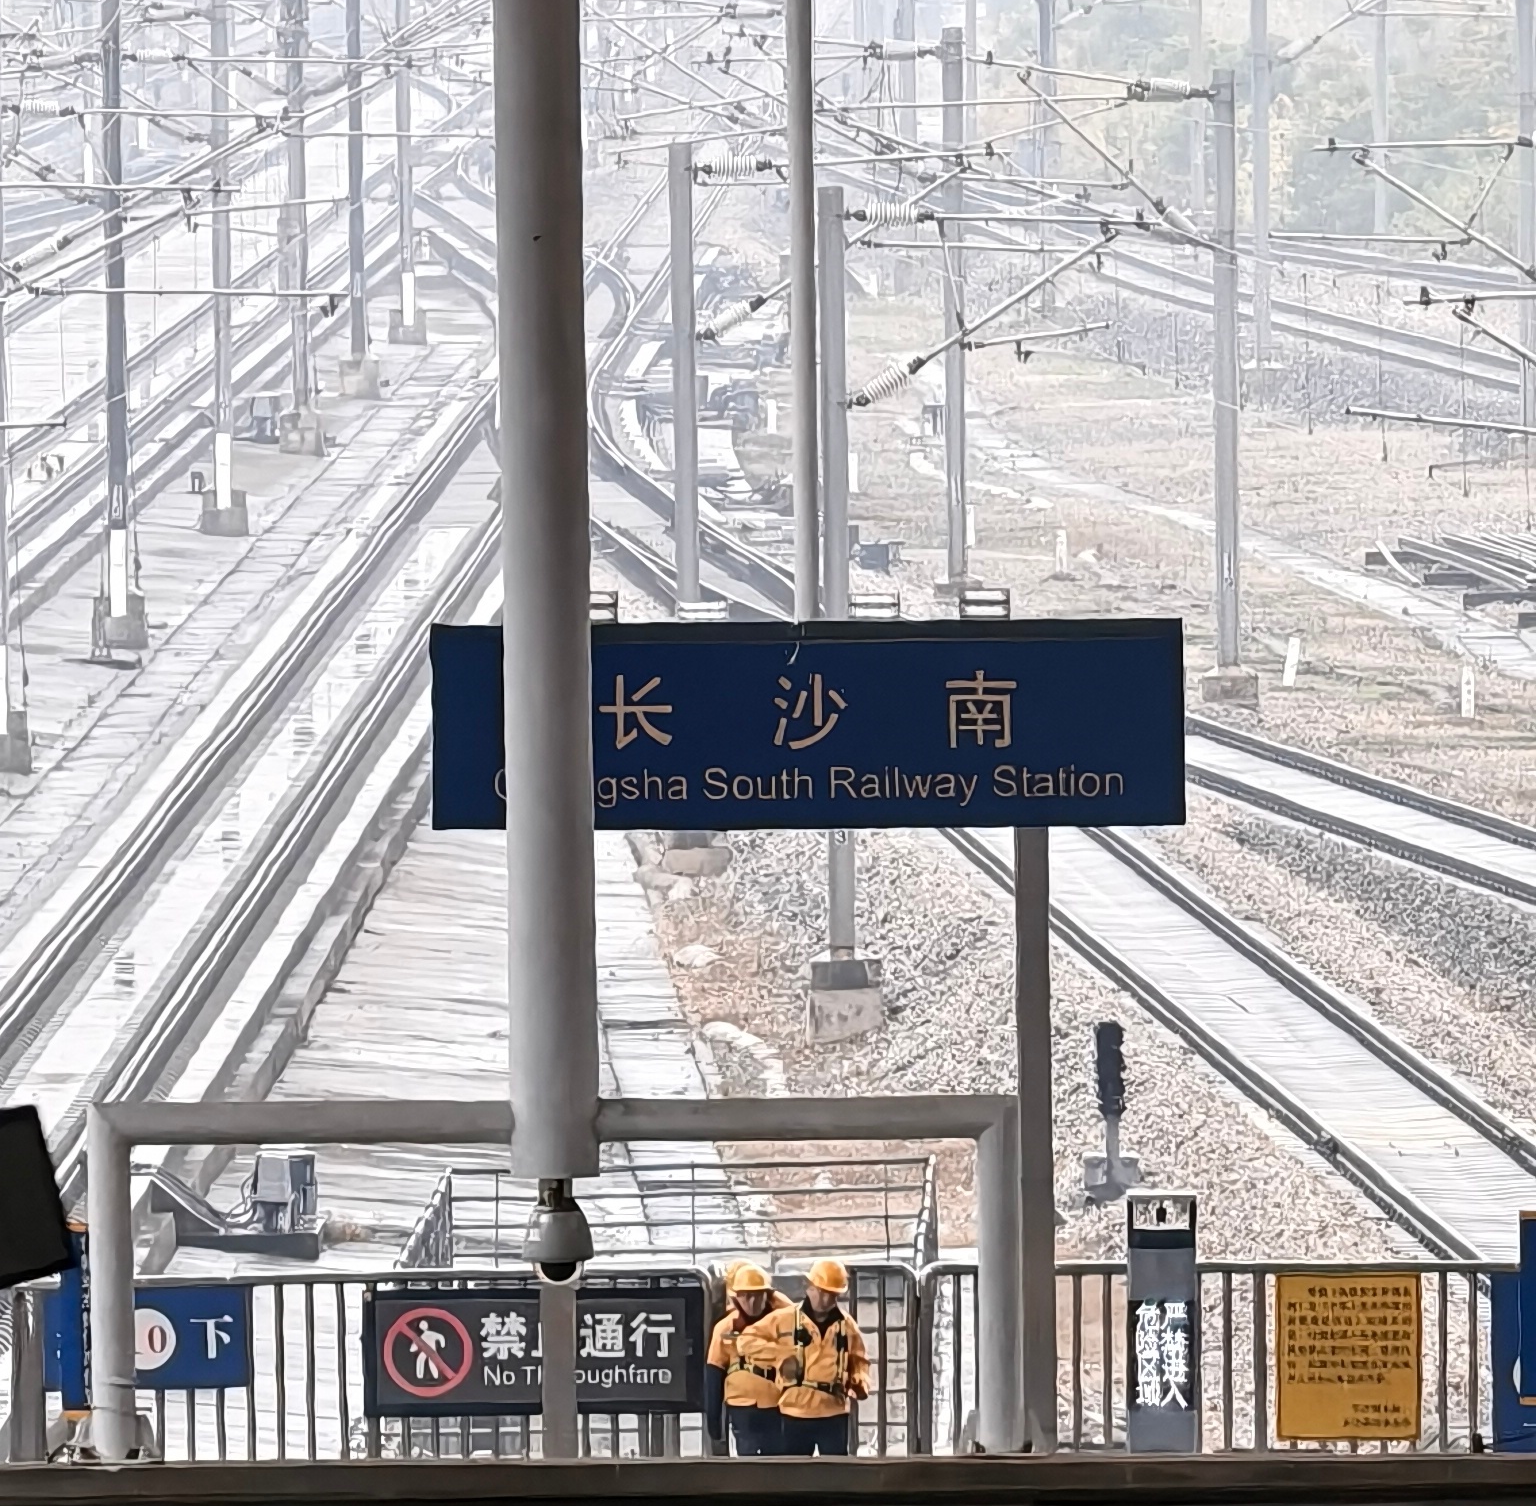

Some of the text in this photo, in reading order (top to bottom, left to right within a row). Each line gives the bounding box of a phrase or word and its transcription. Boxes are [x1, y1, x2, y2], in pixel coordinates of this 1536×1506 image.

[598, 669, 1018, 750] 长沙南
[703, 765, 814, 801] South
[828, 763, 980, 808] Railway
[992, 763, 1125, 798] Station
[188, 1313, 235, 1360] 下
[483, 1363, 516, 1386] No
